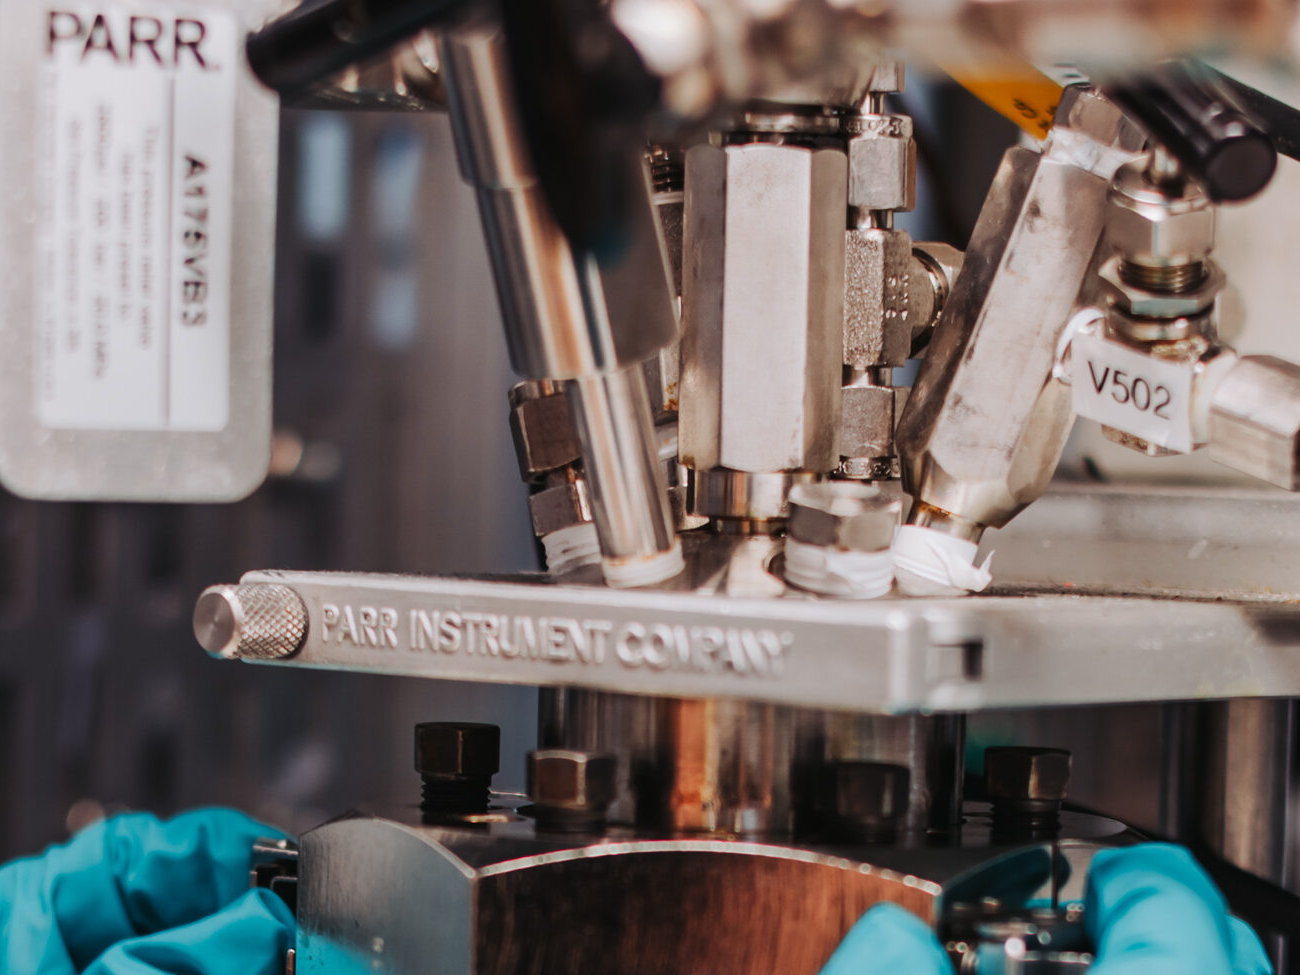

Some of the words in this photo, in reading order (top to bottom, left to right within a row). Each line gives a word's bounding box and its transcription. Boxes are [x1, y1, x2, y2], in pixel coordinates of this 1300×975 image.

[1086, 360, 1172, 420] V502
[321, 604, 398, 649] PARR
[409, 609, 612, 664] INSTRUMENT
